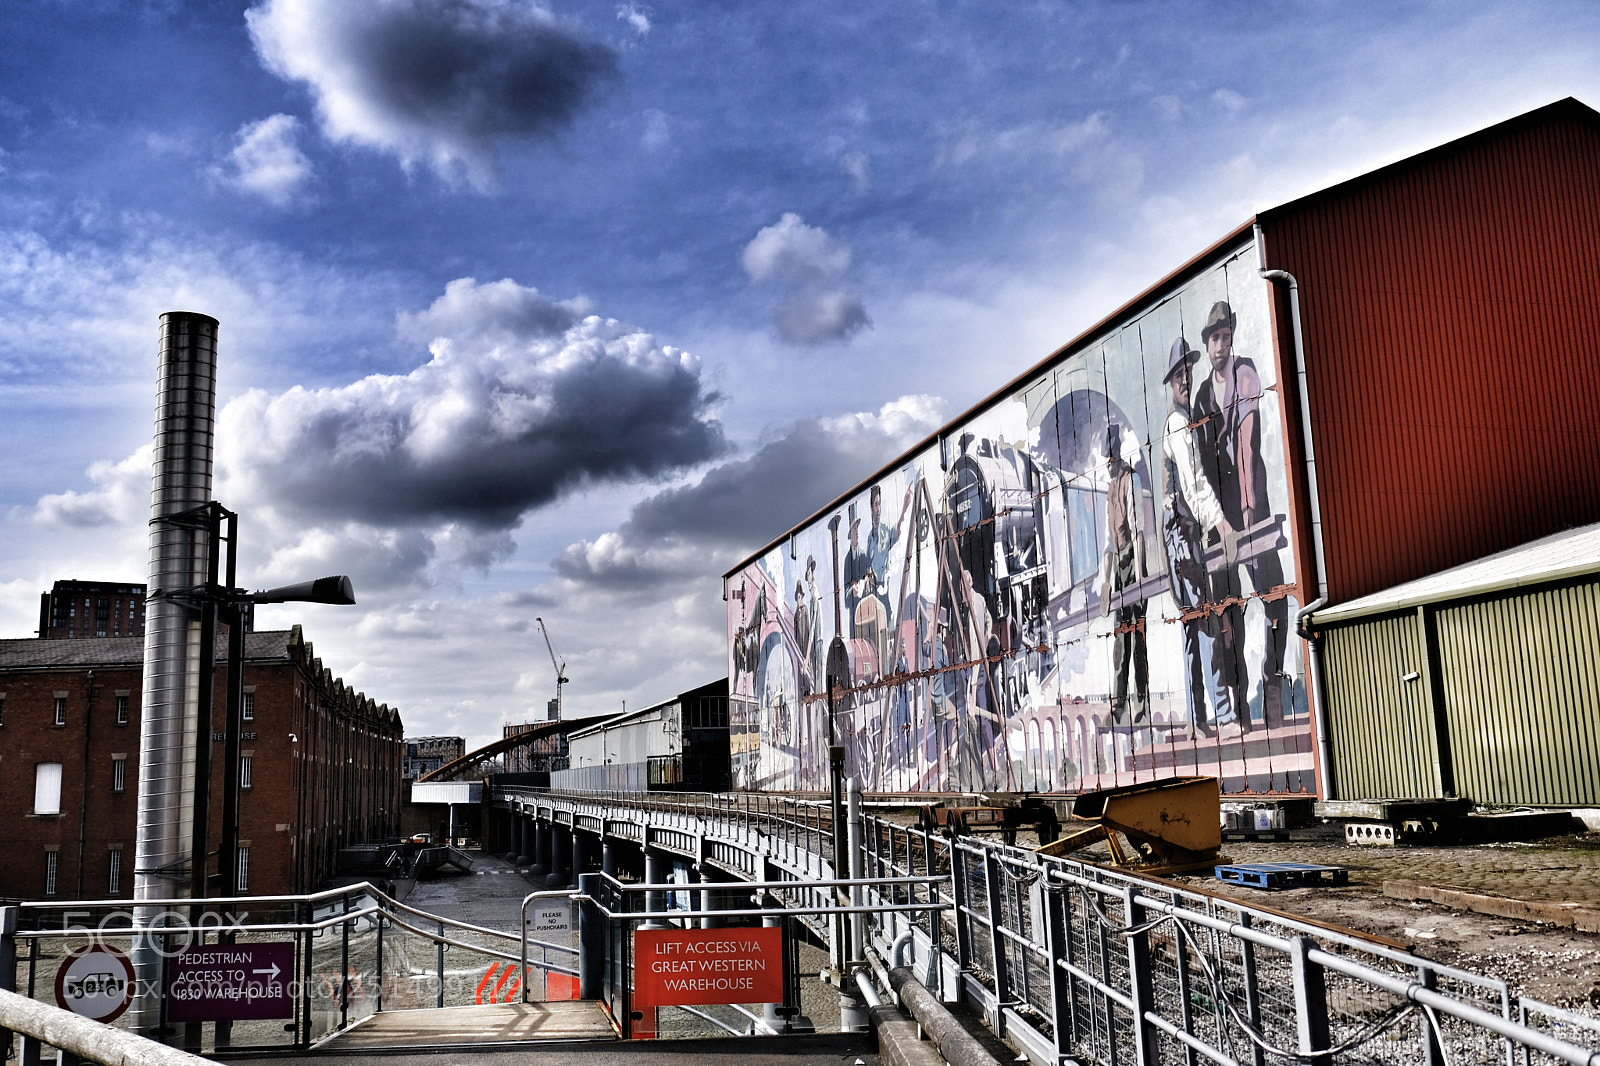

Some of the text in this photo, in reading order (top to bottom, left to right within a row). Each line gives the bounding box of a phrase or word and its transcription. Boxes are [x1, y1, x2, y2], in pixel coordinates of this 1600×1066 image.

[655, 940, 762, 955] LIFT ACCESS VIA
[178, 952, 252, 965] PEDESTRIAN
[651, 959, 766, 973] GREAT WESTERN
[177, 969, 245, 983] ACCESS TO
[664, 977, 754, 991] WAREHOUSE
[177, 986, 282, 1000] 1830 WAREHOUSE
